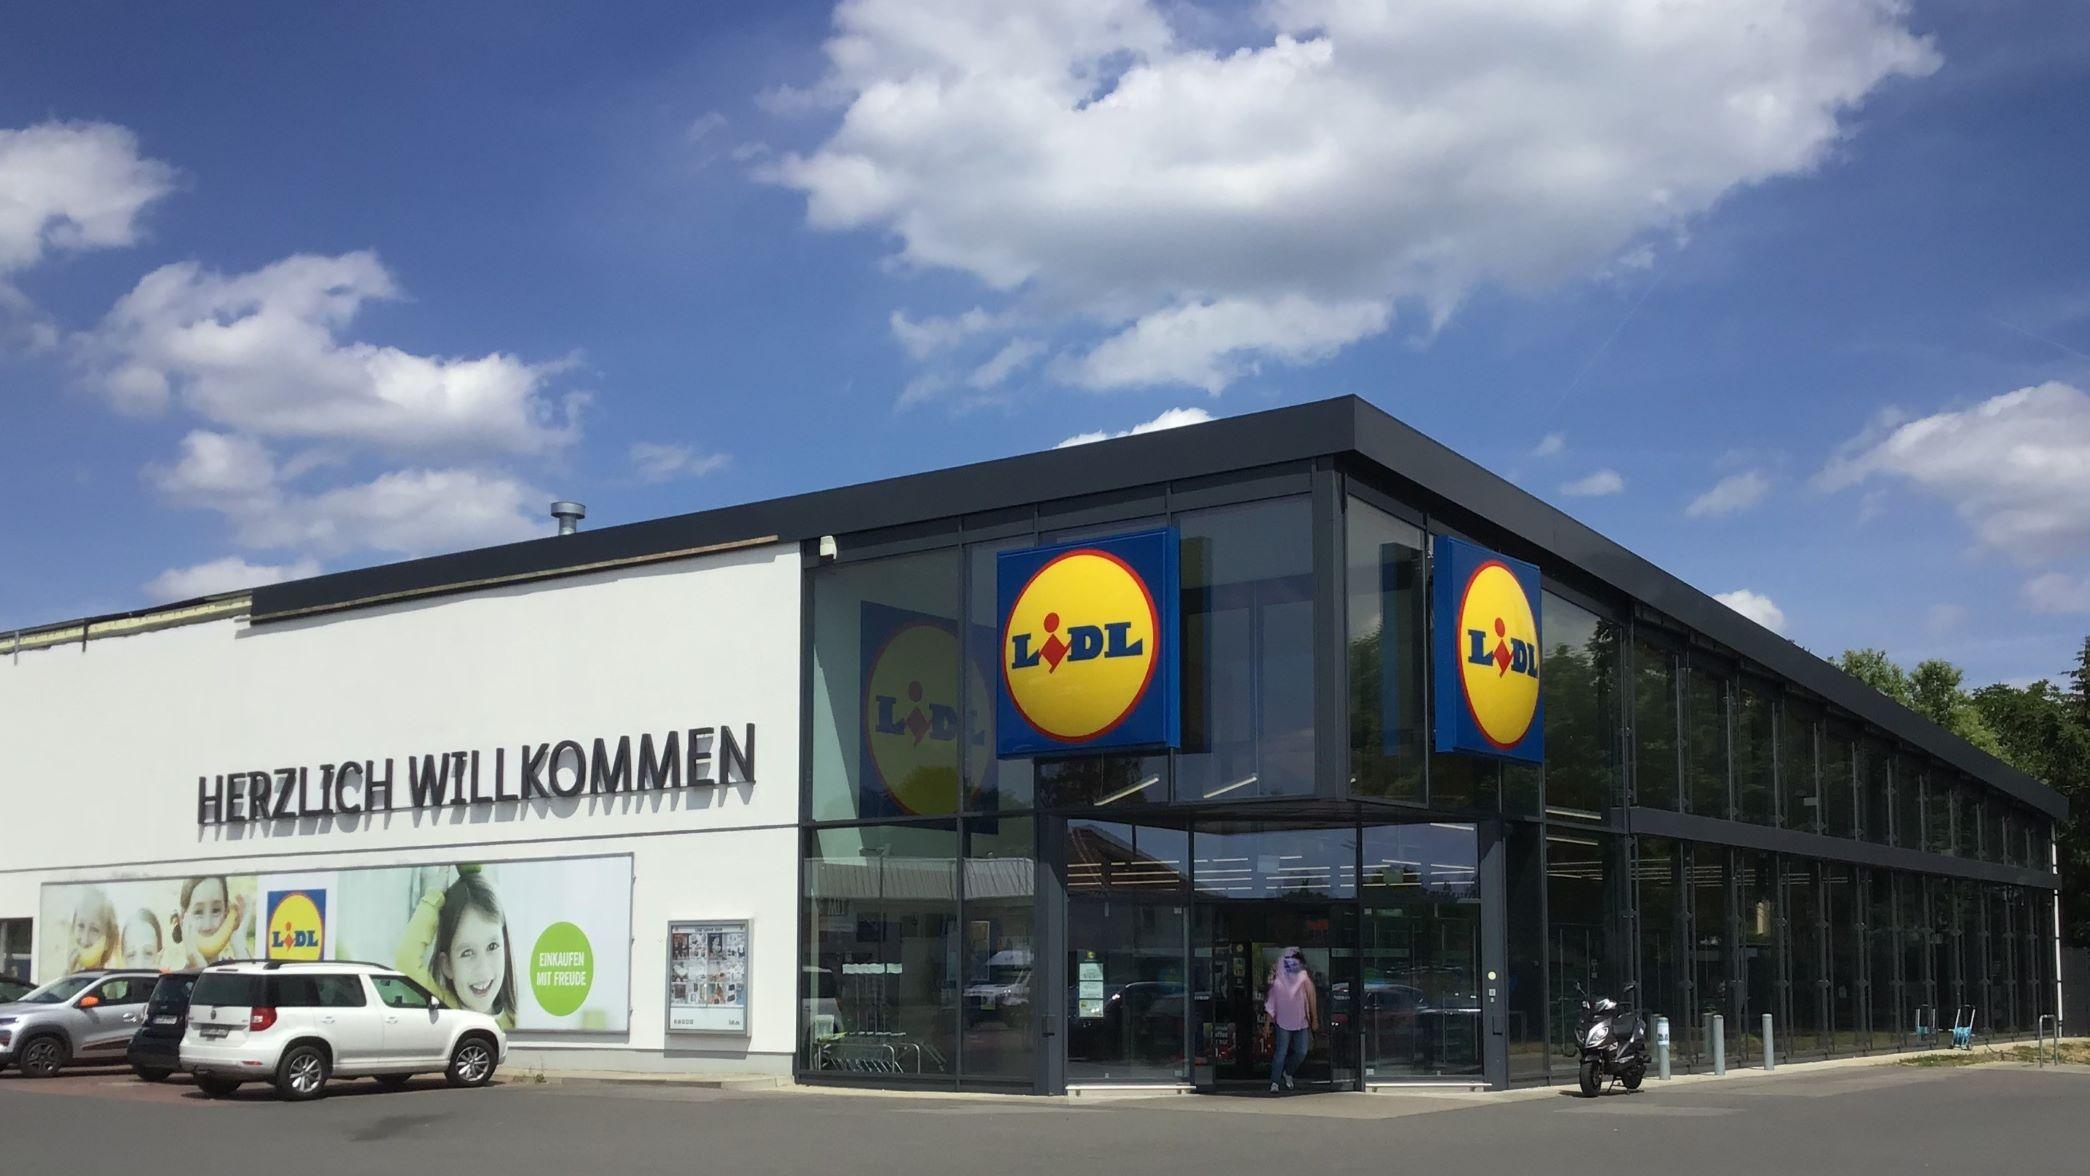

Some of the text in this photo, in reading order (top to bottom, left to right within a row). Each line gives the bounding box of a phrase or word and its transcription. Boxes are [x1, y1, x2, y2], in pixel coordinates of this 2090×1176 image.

[198, 722, 756, 825] HERZLICH WILLKOMMEN
[539, 951, 585, 967] EINKAUFEN
[536, 971, 587, 986] MIT FREUDE
